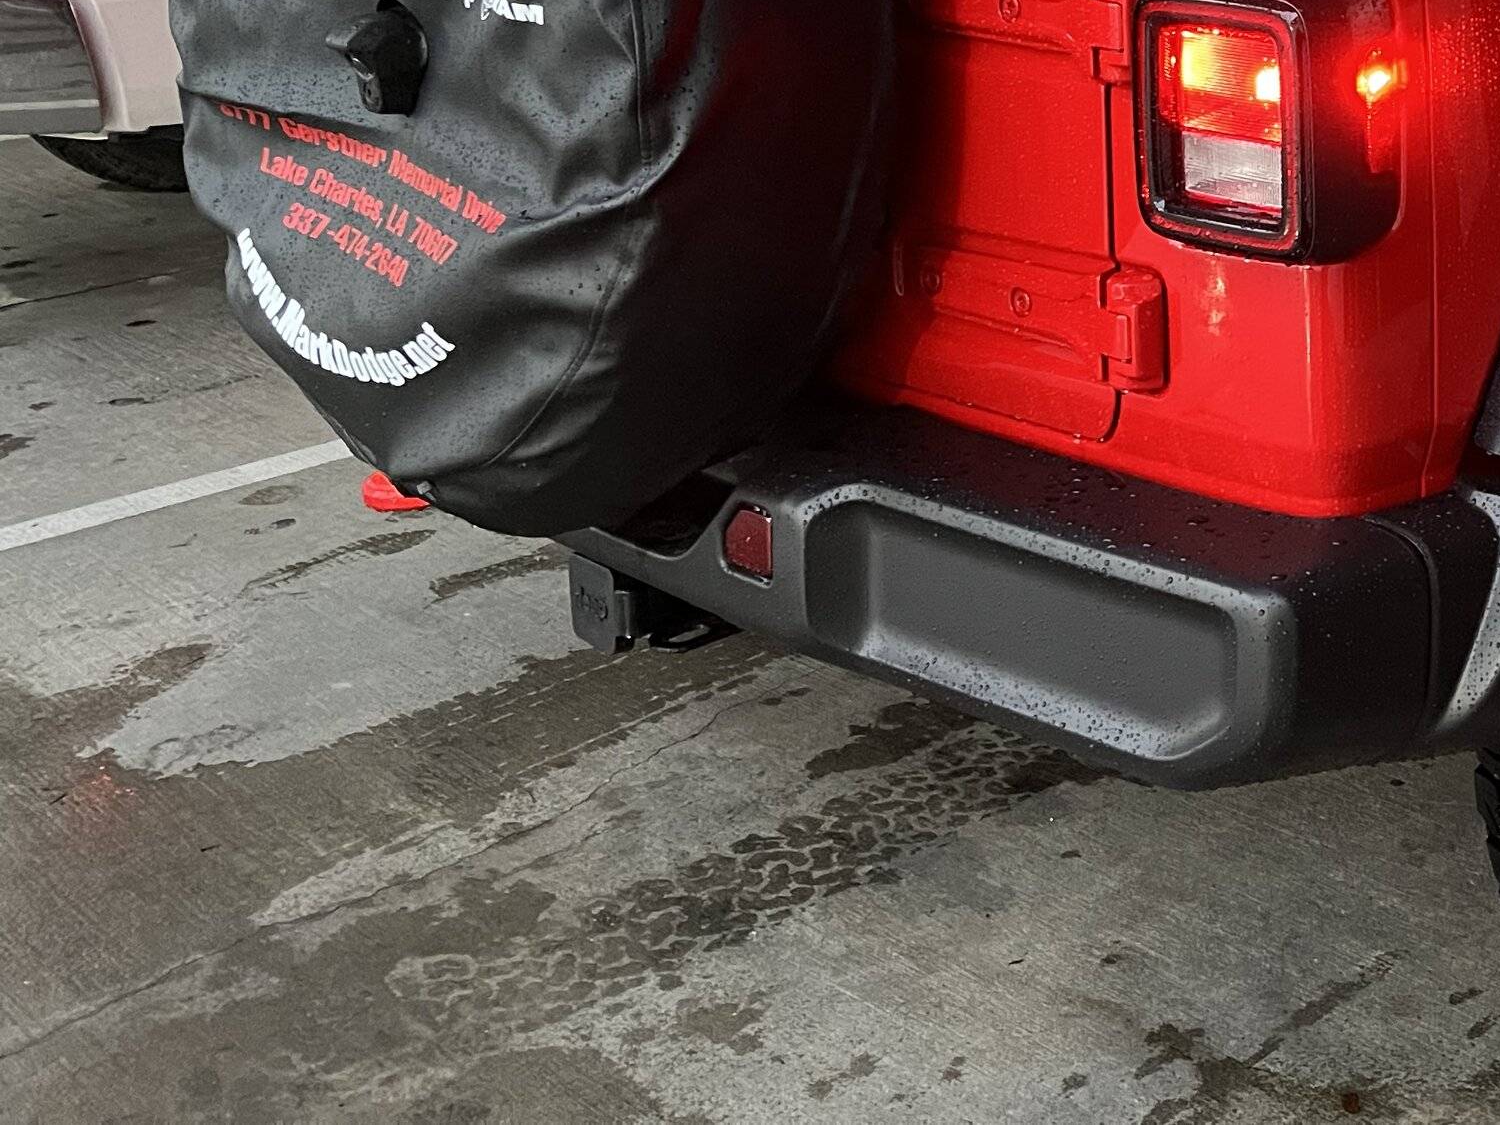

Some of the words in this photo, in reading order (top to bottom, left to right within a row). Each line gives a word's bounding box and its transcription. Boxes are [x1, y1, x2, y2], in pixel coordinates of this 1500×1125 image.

[260, 147, 309, 186] Lake
[309, 168, 384, 228] Charles,
[385, 203, 409, 236] LA
[408, 216, 458, 265] 70607
[388, 149, 463, 212] Memorial
